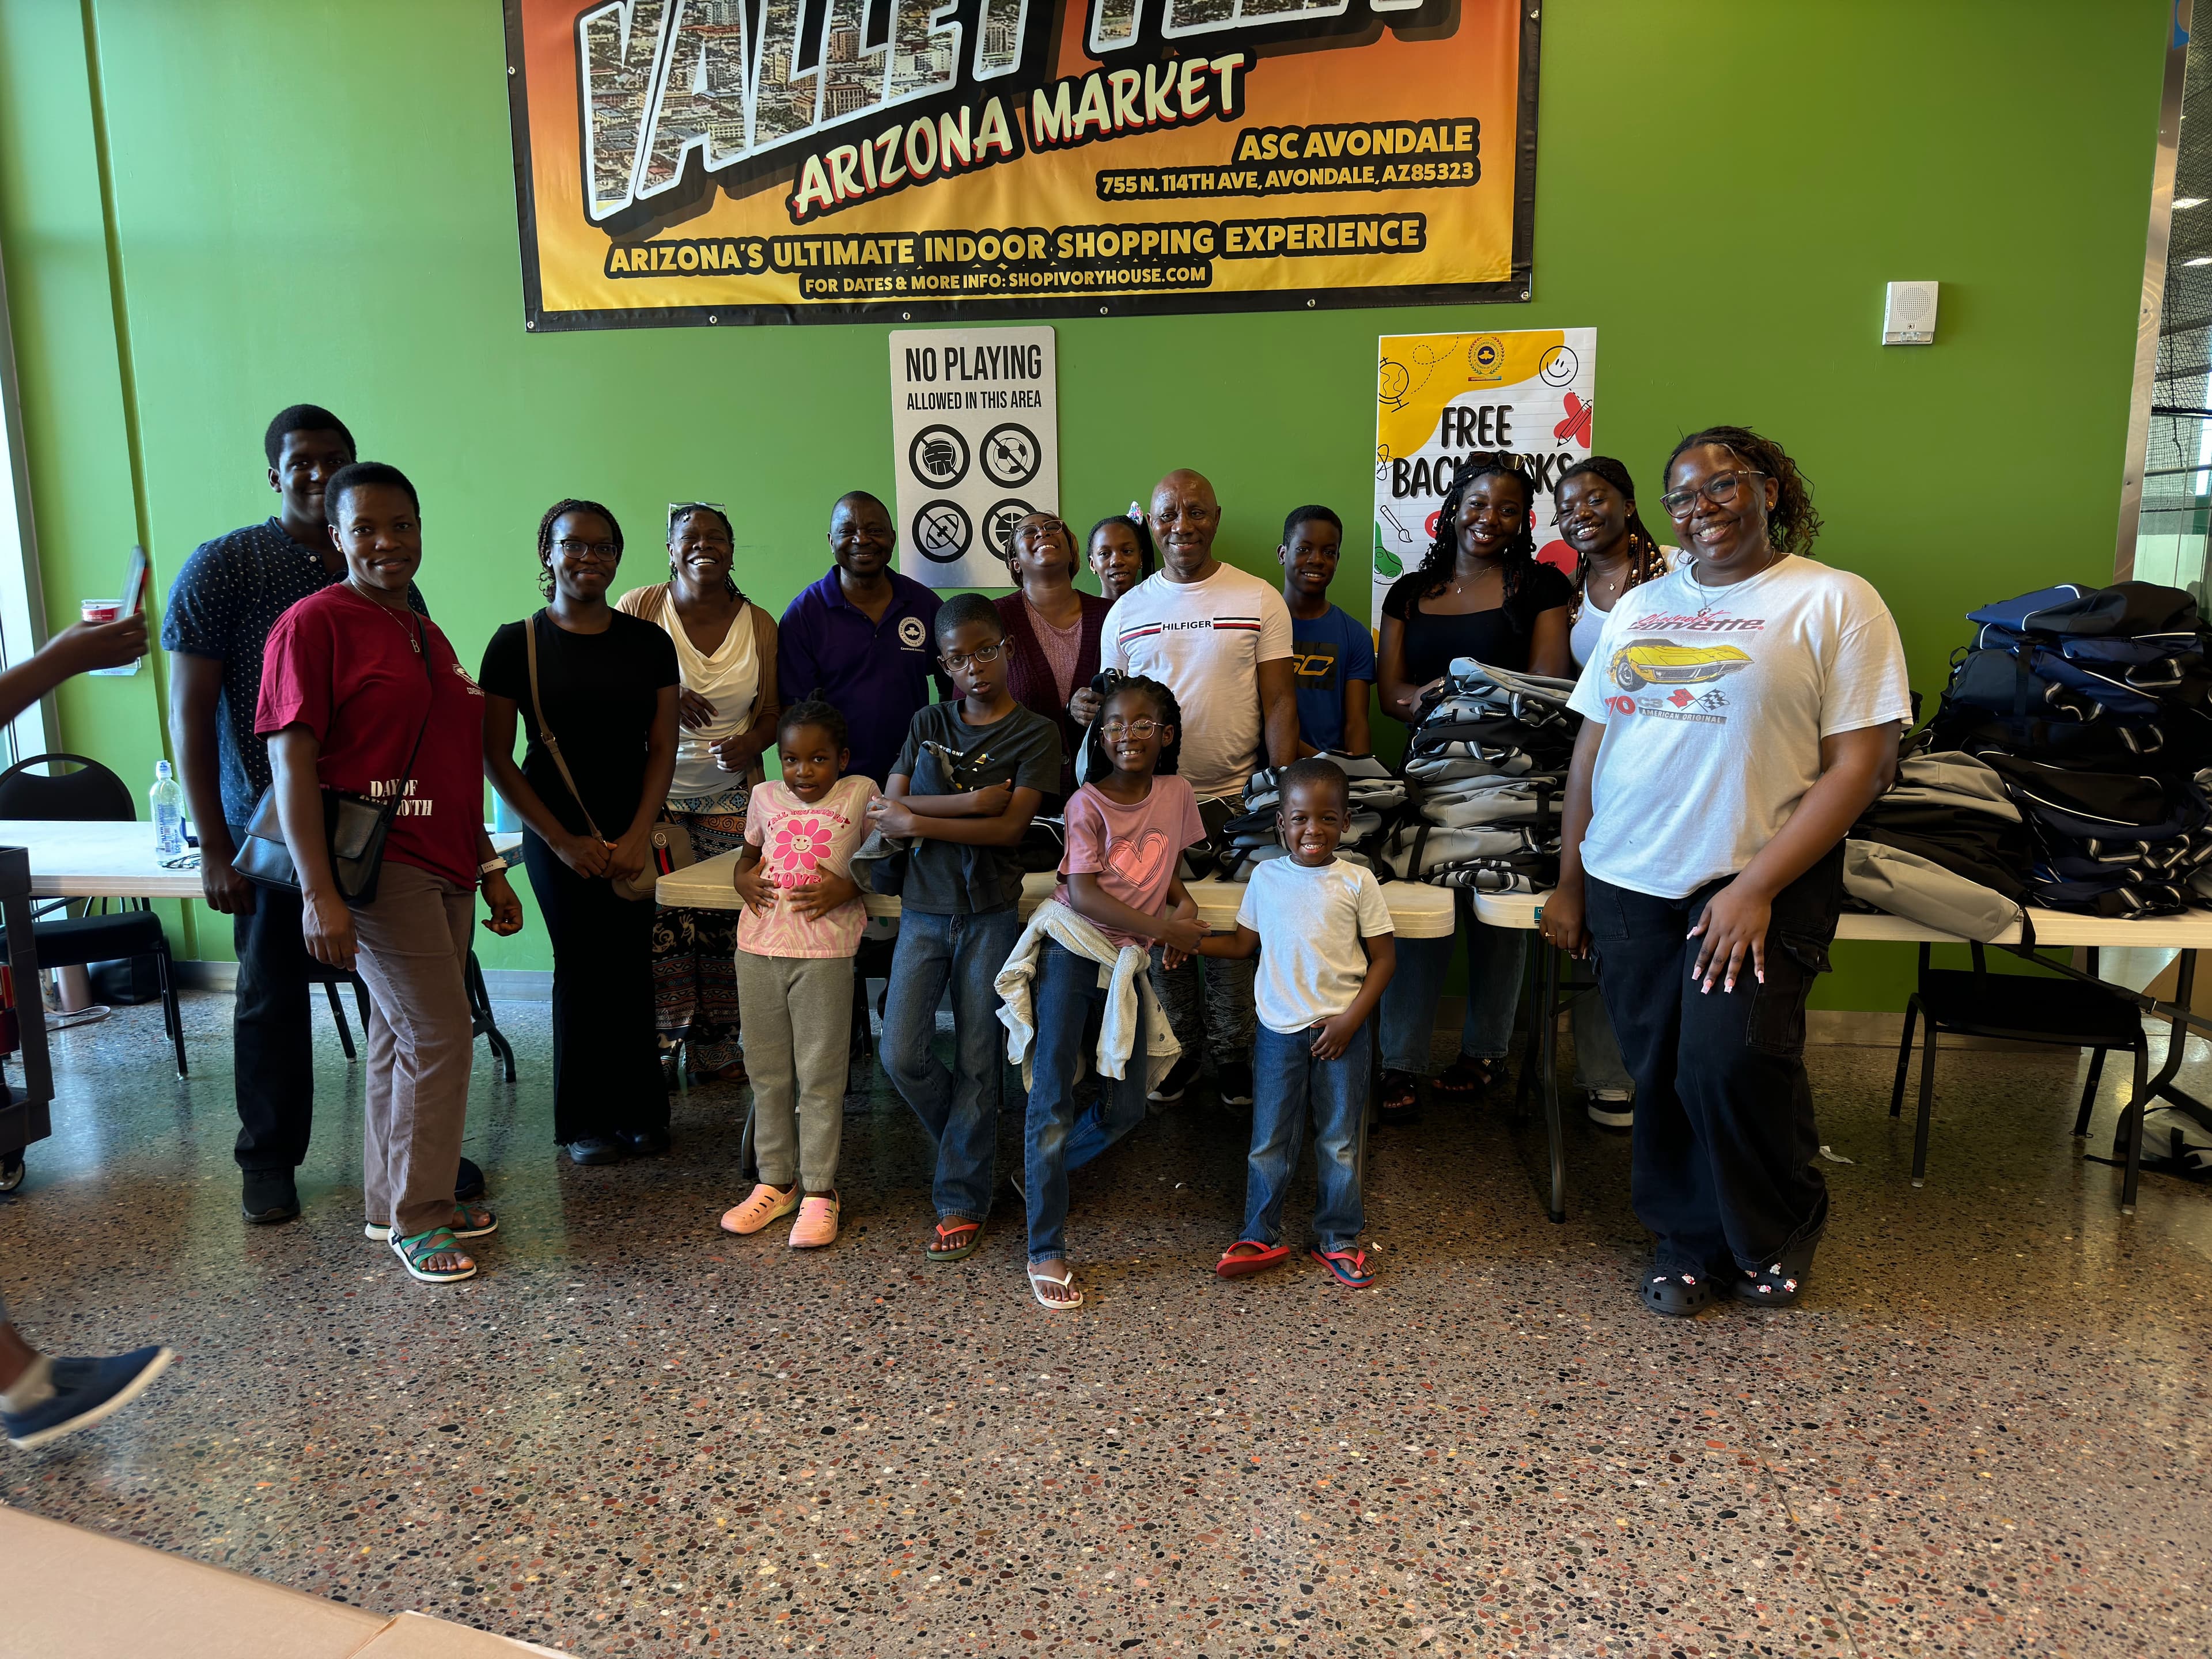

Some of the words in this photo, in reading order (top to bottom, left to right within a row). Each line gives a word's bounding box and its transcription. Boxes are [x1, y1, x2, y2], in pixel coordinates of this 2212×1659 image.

[794, 94, 1013, 218] ARIZONA
[1032, 52, 1245, 147] MARKET
[1238, 132, 1299, 161] ASC
[1303, 124, 1474, 158] AVONDALE
[1102, 176, 1137, 195] 755
[1140, 175, 1158, 193] N.
[1162, 172, 1215, 192] 114TH
[1217, 171, 1263, 191] AVE,
[1264, 166, 1380, 188] AVONDALE,
[609, 243, 763, 272] ARIZONA'S
[774, 238, 914, 267] ULTIMATE
[925, 231, 1046, 263] INDOOR
[1057, 228, 1214, 259] SHOPPING
[1226, 219, 1419, 252] EXPERIENCE
[805, 277, 838, 293] FOR
[844, 276, 892, 292] DATES
[896, 275, 907, 290] &
[911, 274, 959, 290] MORE
[963, 273, 1006, 289] INFO:
[906, 347, 937, 382] NO
[945, 344, 1042, 381] PLAYING
[907, 392, 962, 410] ALLOWED
[965, 391, 977, 409] IN
[980, 391, 1007, 409] THIS
[1010, 390, 1042, 408] AREA
[1441, 405, 1513, 448] FREE
[1392, 453, 1573, 498] BACKS
[1162, 620, 1211, 631] HILFIGER
[1642, 710, 1680, 720] AMERICAN
[1683, 714, 1722, 724] ORIGINAL
[370, 779, 400, 797] DAY
[771, 812, 788, 824] ALL
[773, 872, 821, 889] LOVE
